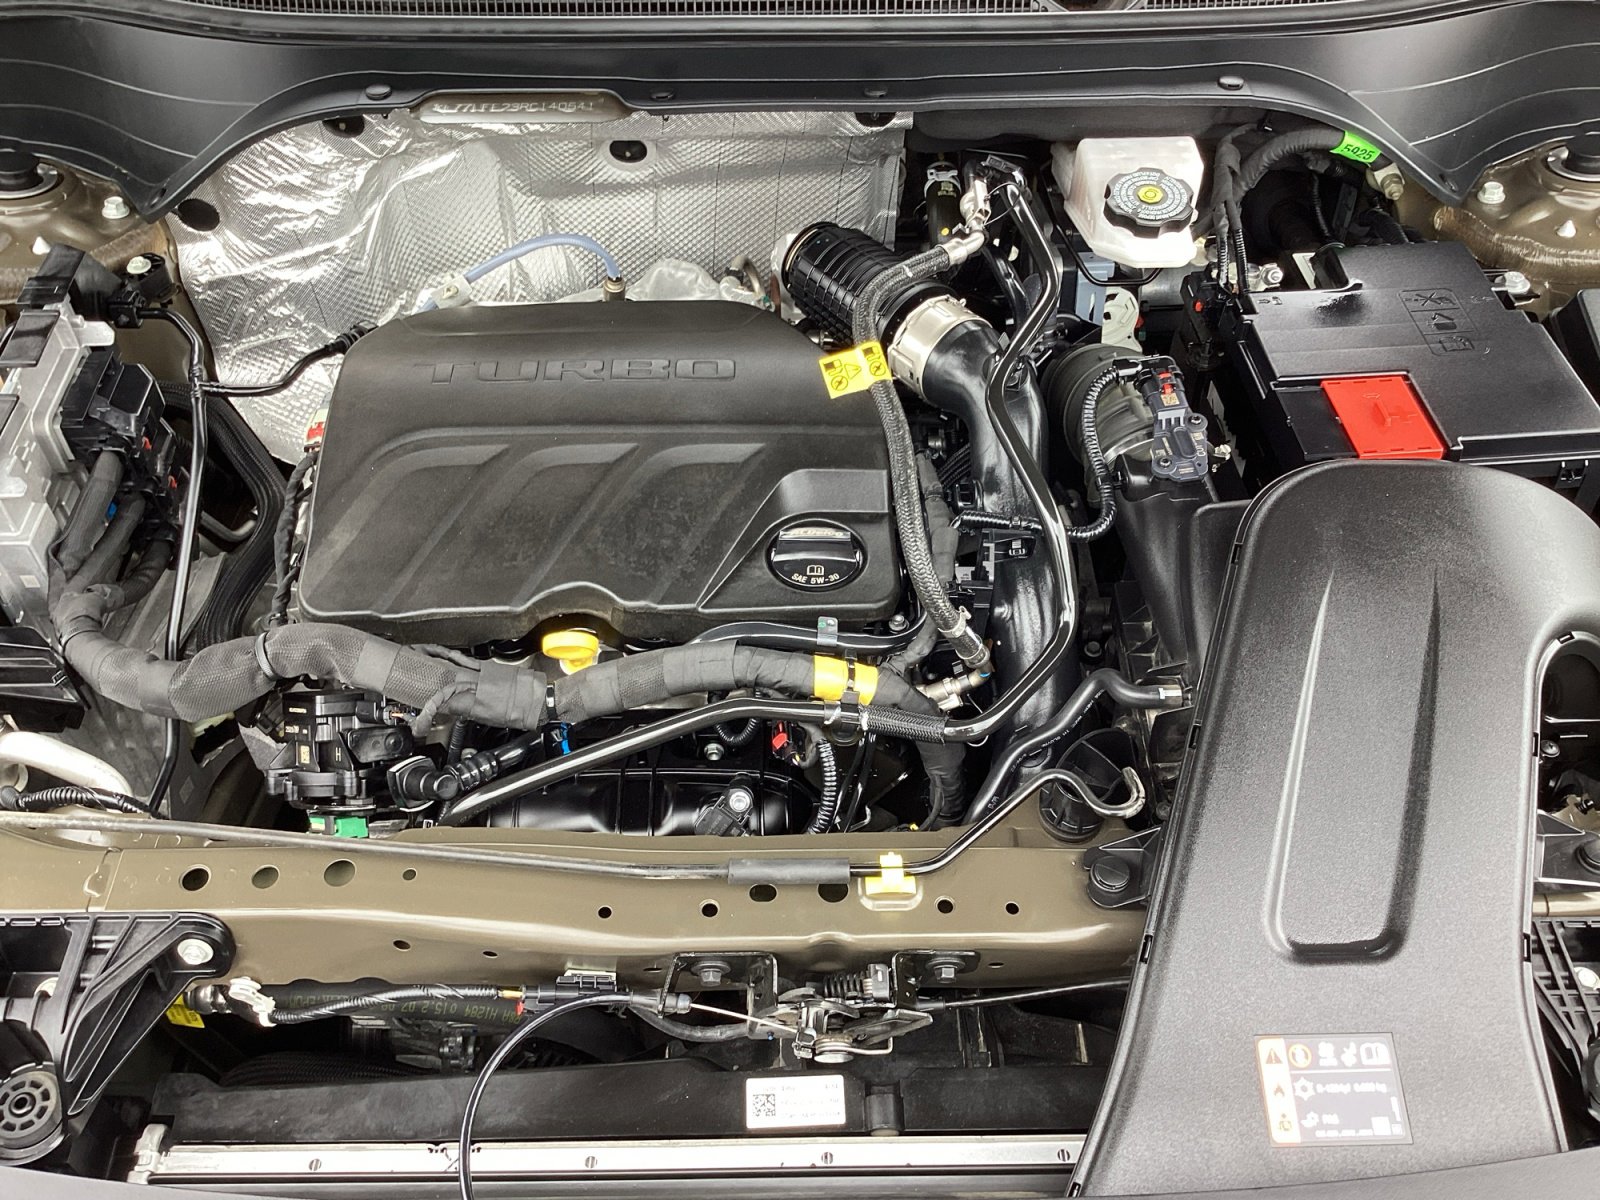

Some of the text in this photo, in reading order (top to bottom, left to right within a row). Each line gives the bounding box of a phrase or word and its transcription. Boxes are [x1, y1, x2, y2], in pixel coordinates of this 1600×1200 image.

[414, 358, 737, 384] TURBO
[791, 573, 840, 584] SAE 5W-30
